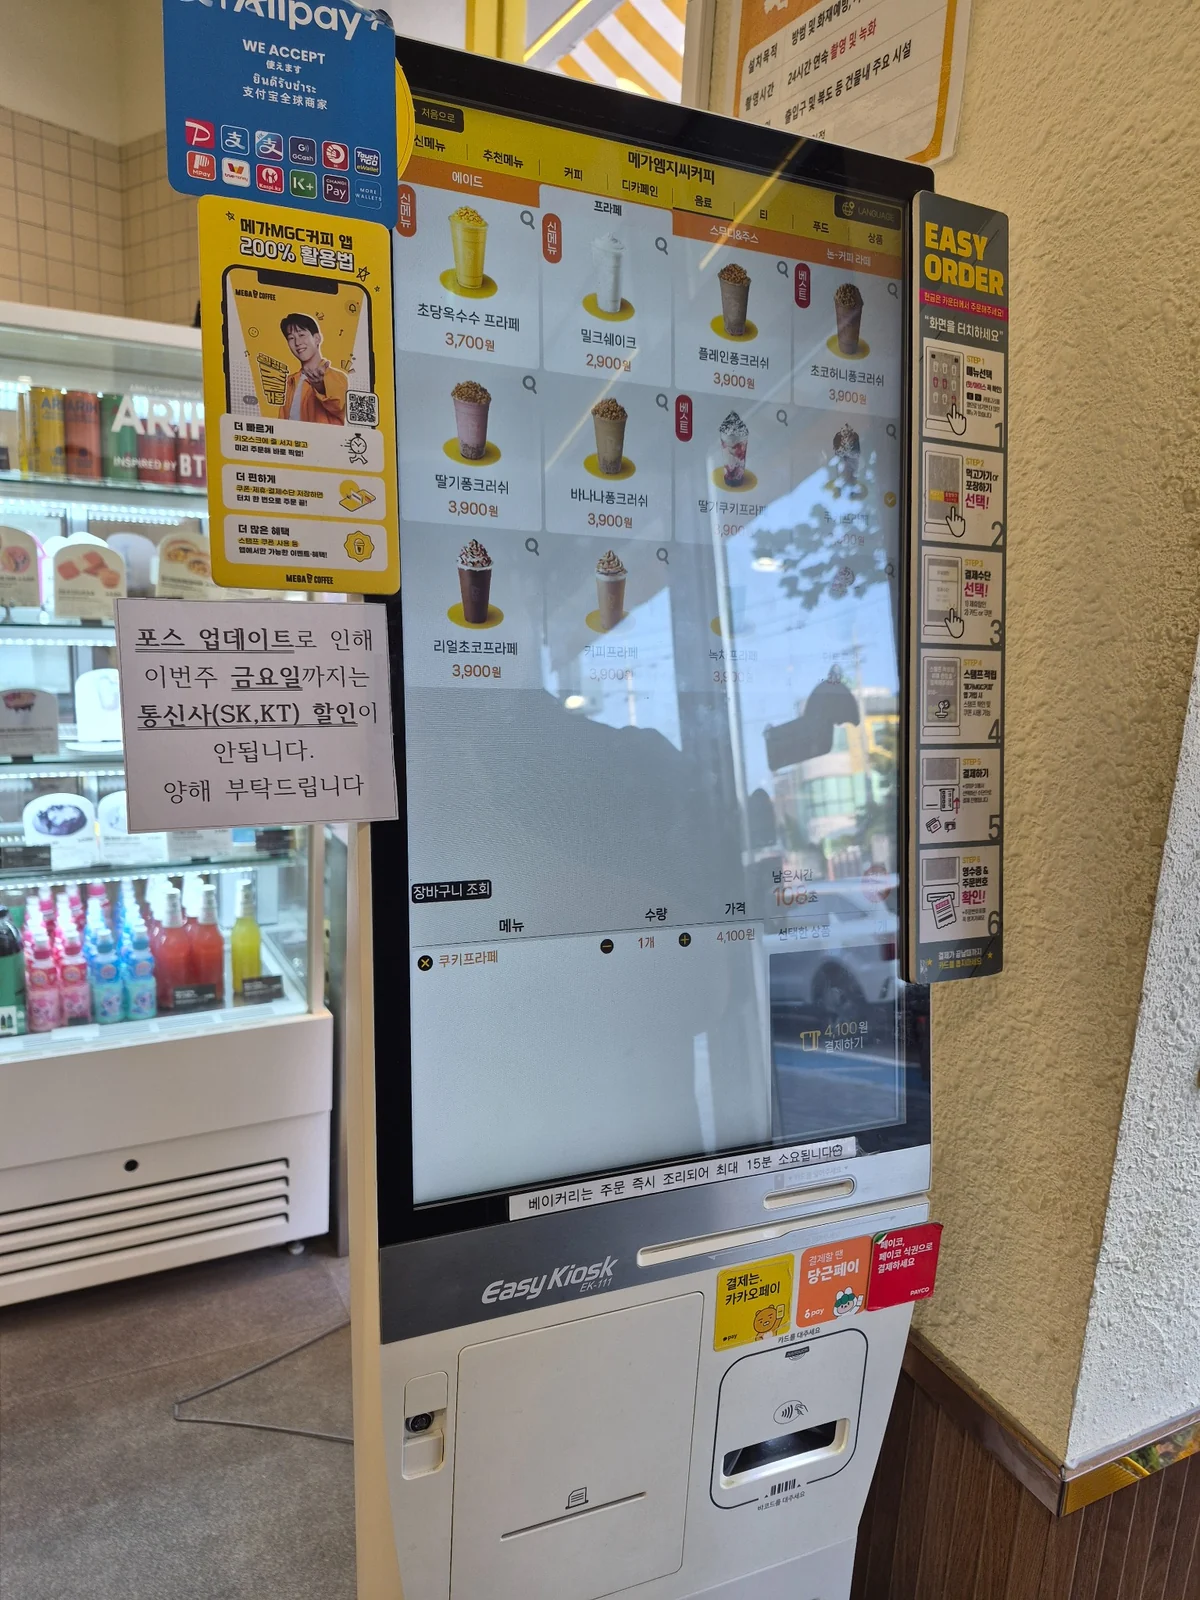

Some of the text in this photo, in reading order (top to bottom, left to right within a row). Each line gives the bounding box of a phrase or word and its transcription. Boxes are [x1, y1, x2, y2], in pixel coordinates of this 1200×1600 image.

[791, 18, 816, 46] 방범 및
[243, 38, 326, 65] WE ACCEPT
[748, 43, 778, 75] 설치목적
[787, 17, 878, 86] 24시간 연속 촬영 및 녹화
[266, 60, 302, 75] 使えます
[785, 39, 913, 125] 출입구 및 복도 등 건물내 주요 시설
[242, 86, 328, 111] 支付宝全球商家
[745, 81, 775, 112] 촬영시간
[421, 108, 455, 124] 처음으로
[292, 153, 314, 162] GCash
[357, 150, 379, 161] Touch
[356, 164, 379, 173] eWallet
[628, 151, 716, 186] 메가엠지씨커피
[293, 177, 315, 192] K+
[326, 183, 347, 199] Pay
[359, 187, 378, 195] MORE
[414, 134, 883, 246] 신메뉴 추천메뉴 커피 디카페인 음료 티 푸드 상품
[355, 193, 383, 202] WALLETS
[400, 192, 412, 229] 신메뉴
[451, 170, 484, 189] 에이드
[594, 200, 622, 217] 프라페
[709, 224, 759, 245] 스무디&주스
[855, 254, 872, 268] 라떼
[858, 206, 895, 223] LANGUAGE
[240, 218, 353, 250] 메가MGC커피 앱
[547, 221, 557, 256] 신메뉴
[924, 221, 988, 261] EASY
[240, 236, 355, 273] 200% 활용법
[924, 253, 1004, 297] ORDER
[235, 288, 277, 301] MEGA COFFEE
[798, 270, 807, 301] 베스트
[417, 303, 520, 332] 초당옥수수 프라페
[445, 332, 495, 353] 3,700원
[580, 328, 637, 350] 밀크쉐이크
[586, 354, 632, 373] 2,900원
[698, 347, 769, 371] 플레인퐁크러쉬
[713, 372, 755, 390] 3,900원
[810, 365, 885, 388] 초코허니퐁크러쉬
[828, 388, 867, 405] 3,900원
[234, 422, 274, 434] 더 빠르게
[679, 402, 689, 435] 베스트
[994, 422, 1004, 448] 1
[113, 453, 206, 479] INSPIRED BY BT
[966, 468, 992, 480] 먹고가기
[236, 472, 276, 484] 더 편하게
[435, 474, 509, 496] 딸기퐁크러쉬
[966, 480, 992, 493] 포장하기
[571, 488, 648, 508] 바나나퐁크러쉬
[965, 493, 990, 510] 선택!
[448, 500, 499, 518] 3,900원
[238, 524, 290, 536] 더 많은 혜택
[587, 513, 633, 529] 3,900원
[991, 521, 1003, 547] 2
[286, 573, 334, 585] MEGA COFFEE
[965, 569, 991, 581] 결제수단
[964, 582, 988, 598] 선택!
[136, 627, 372, 652] 포스 업데이트로 인해
[990, 619, 1002, 645] 3
[433, 639, 518, 656] 리얼초코프라페
[145, 665, 370, 689] 이번주 금요일까지는
[452, 664, 501, 678] 3,900원
[137, 701, 378, 728] 통신사(SK,KT) 할인이
[988, 719, 1001, 743] 4
[213, 740, 314, 764] 안됩니다.
[963, 768, 989, 779] 결제하기
[164, 774, 364, 804] 양해 부탁드립니다
[988, 814, 1000, 840] 5
[772, 869, 813, 884] 남은시간
[983, 866, 989, 875] &
[413, 881, 490, 900] 장바구니 조회
[962, 877, 988, 888] 주문번호
[773, 886, 819, 907] 108초
[962, 889, 986, 905] 확인!
[499, 902, 746, 933] 메뉴 수량 가격
[988, 910, 1000, 937] 6
[778, 924, 831, 941] 선택한 상품
[438, 928, 756, 968] 쿠키프라페 1개 4,100원
[824, 1021, 868, 1037] 4,100원
[824, 1037, 864, 1053] 결제하기
[528, 1145, 832, 1211] 베이커리는 주문 즉시 조리되어 최대 15분 소요됩니다
[879, 1241, 933, 1262] 페이코 식권으로
[880, 1236, 905, 1250] 페이코,
[808, 1252, 833, 1267] 결제할
[877, 1257, 915, 1275] 결제하세요
[481, 1256, 618, 1304] Easy Kiosk
[726, 1272, 763, 1291] 결제는.
[807, 1259, 860, 1285] 당근페이
[579, 1277, 612, 1293] EK-111
[725, 1281, 780, 1306] 카카오페이
[910, 1287, 930, 1296] PAYCO
[811, 1308, 825, 1318] pay
[727, 1333, 738, 1342] pay
[777, 1327, 821, 1344] 카드를 대주세요
[757, 1491, 806, 1512] 바코드를 대주세요
